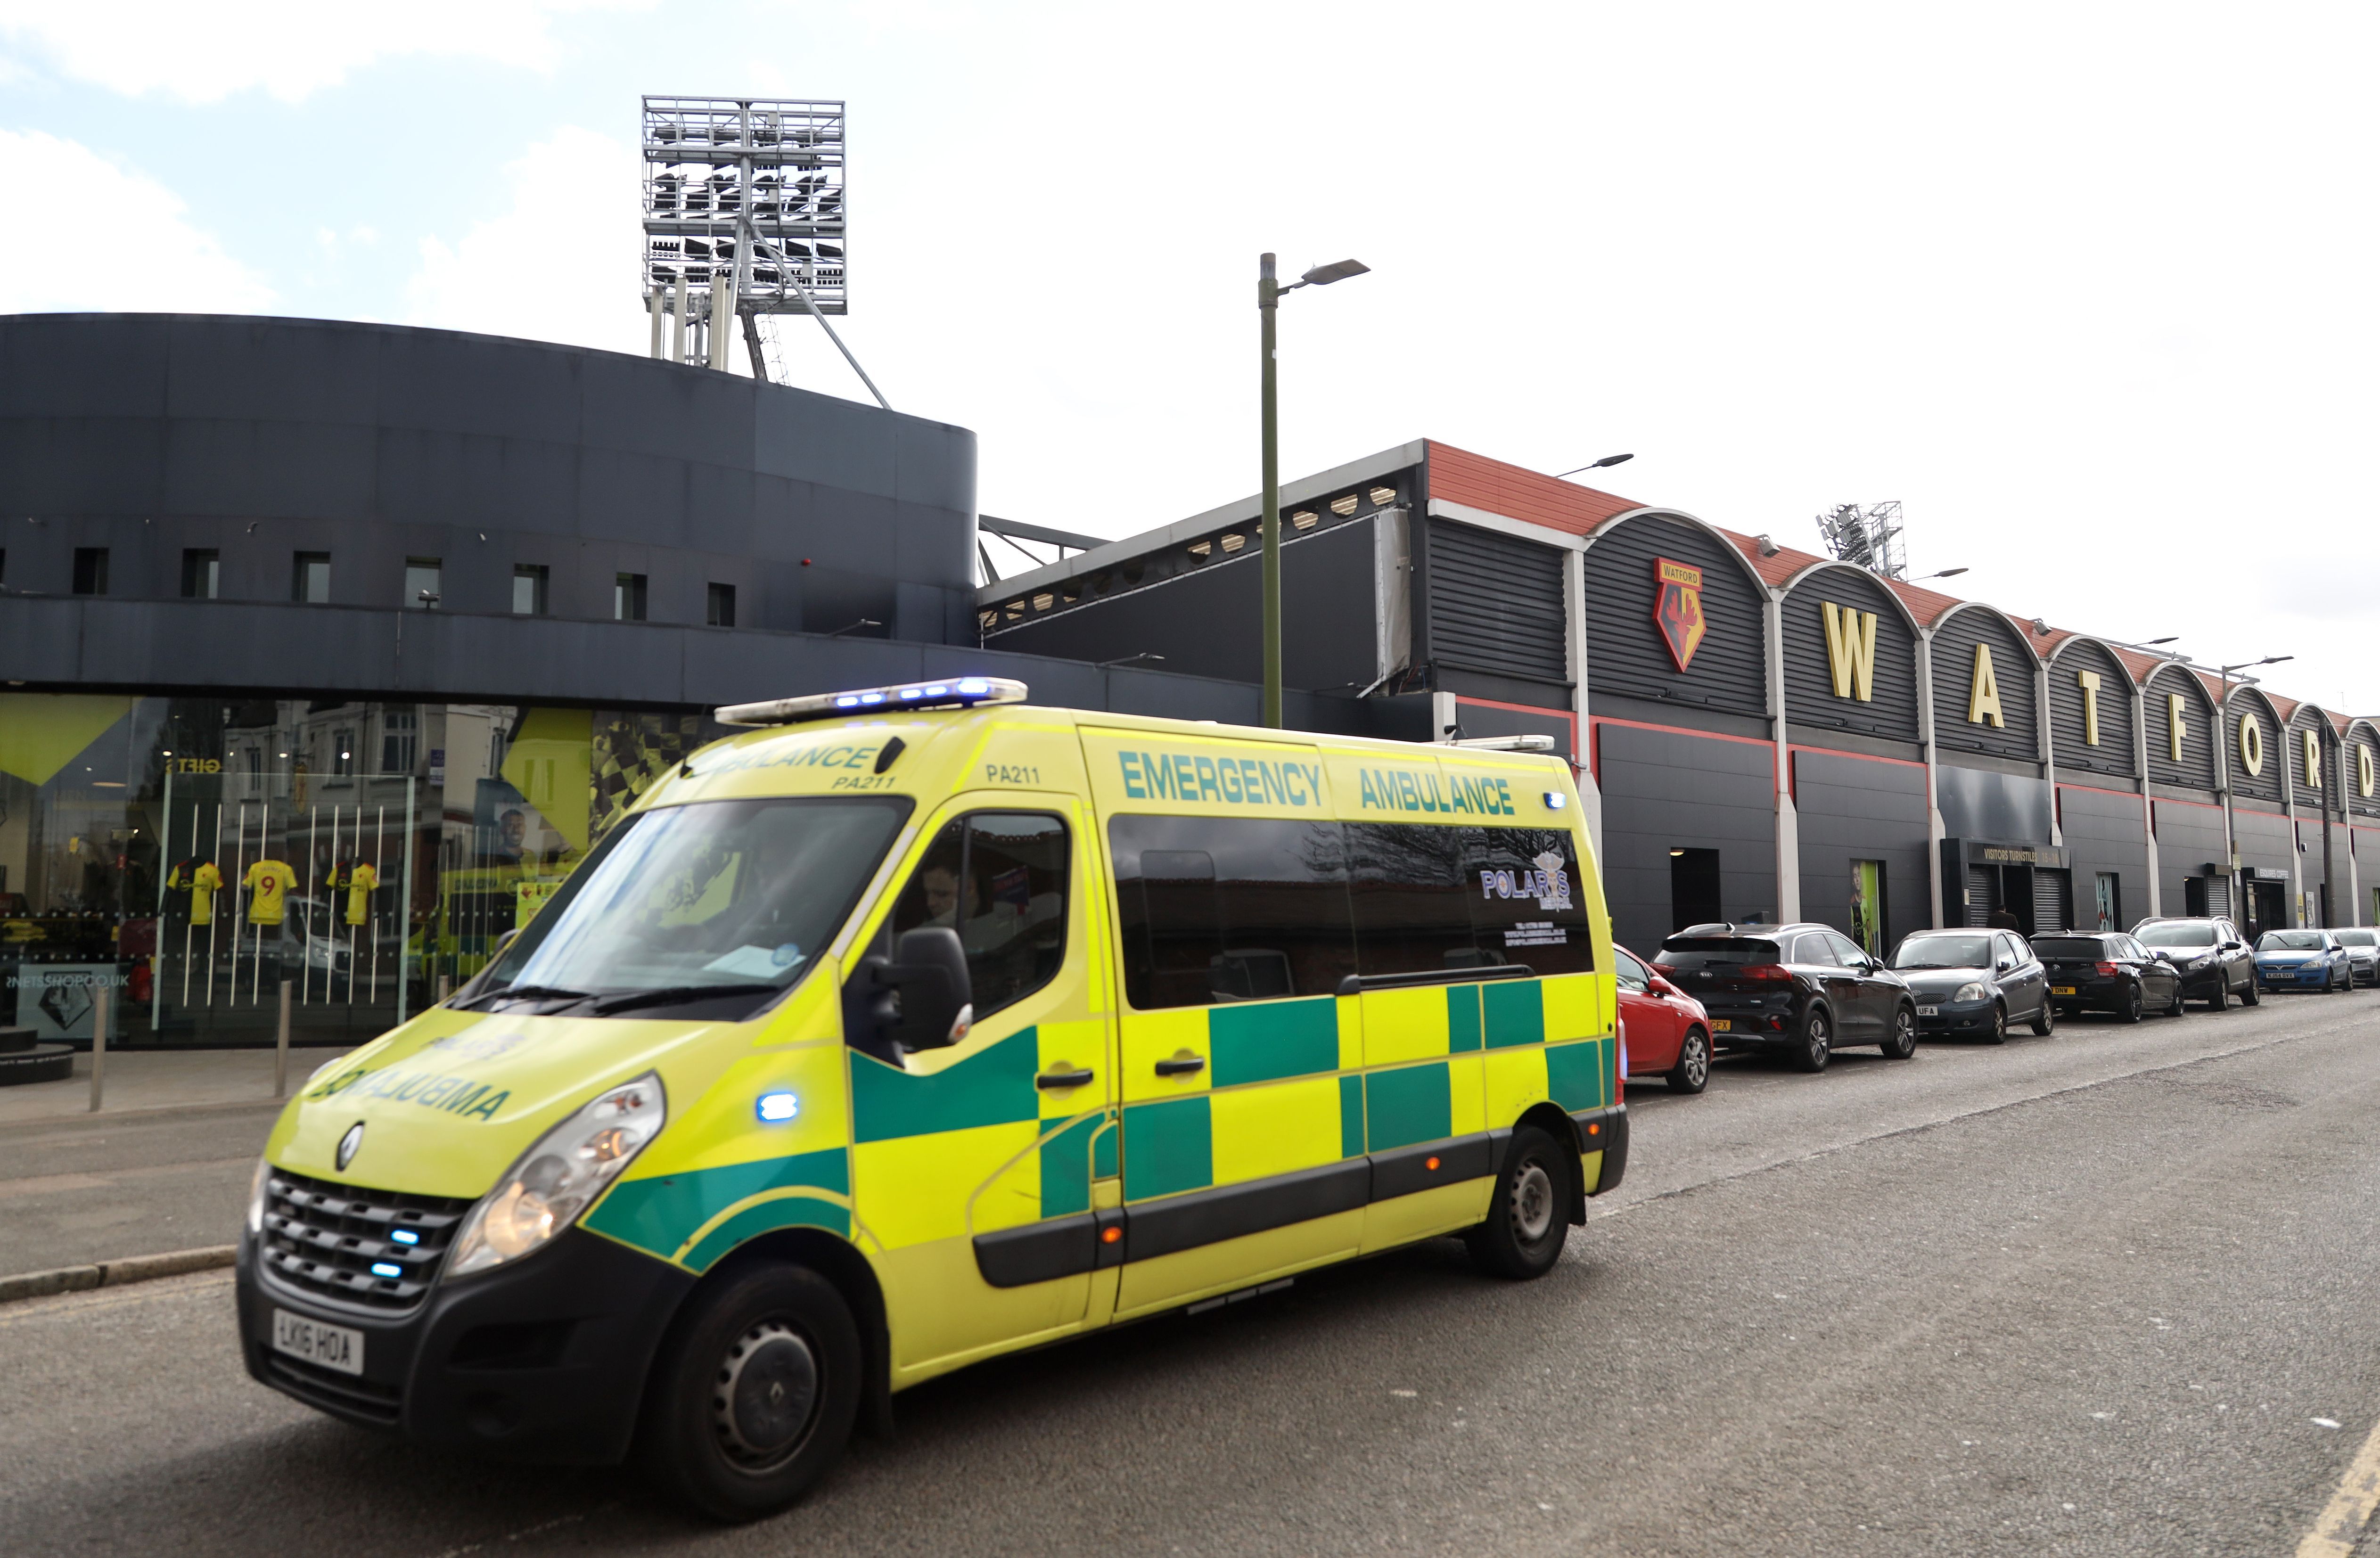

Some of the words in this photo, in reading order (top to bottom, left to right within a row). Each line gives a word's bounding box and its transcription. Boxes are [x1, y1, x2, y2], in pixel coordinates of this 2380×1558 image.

[1664, 565, 1697, 583] WATFORD
[832, 776, 896, 789] PA211
[986, 763, 1040, 784] PA211
[1118, 750, 1321, 806] EMERGENCY
[1359, 767, 1515, 816] AMBULANCE
[1984, 848, 2008, 861] VISITORS
[2009, 851, 2038, 863] TURNSTILES
[2260, 869, 2276, 877] ESQUIRES
[2277, 870, 2289, 879] COFFEE
[261, 876, 275, 896] 9
[1712, 1020, 1727, 1030] GFX
[317, 1326, 351, 1365] HOA
